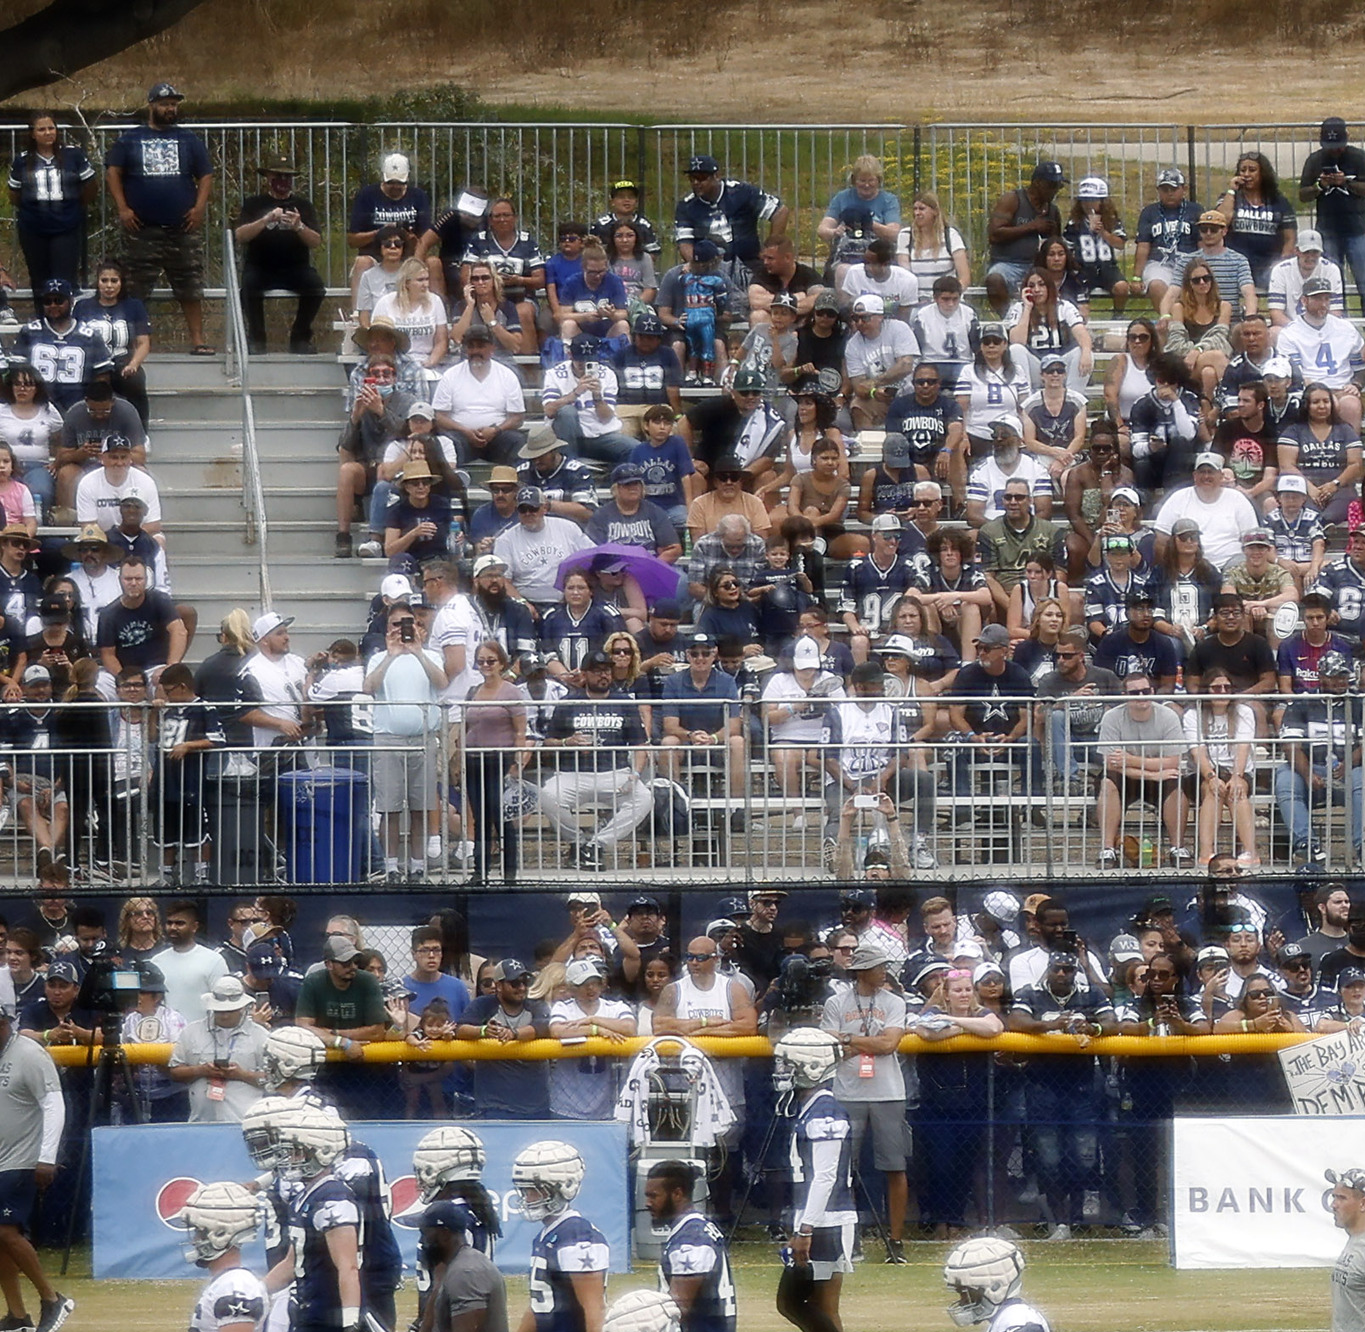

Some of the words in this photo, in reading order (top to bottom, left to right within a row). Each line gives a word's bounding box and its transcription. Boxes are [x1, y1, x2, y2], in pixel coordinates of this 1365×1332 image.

[36, 169, 63, 200] 11
[1238, 209, 1272, 220] DALLAS
[1030, 325, 1062, 349] 21
[31, 345, 86, 383] 63
[1315, 341, 1337, 375] 4
[987, 384, 1002, 403] 8
[902, 418, 945, 434] COWBOYS
[1303, 442, 1341, 453] DALLAS
[609, 520, 652, 540] COWBOYS
[523, 546, 563, 566] COWBOYS
[5, 592, 26, 622] 4
[860, 595, 899, 631] 94
[1171, 582, 1197, 624] 8
[557, 638, 589, 670] 11
[163, 720, 189, 746] 21
[573, 715, 624, 729] COWBOYS
[687, 1008, 724, 1019] COWBOYS
[1288, 1053, 1316, 1075] THE
[1313, 1040, 1347, 1067] BAY
[1189, 1188, 1306, 1212] BANK
